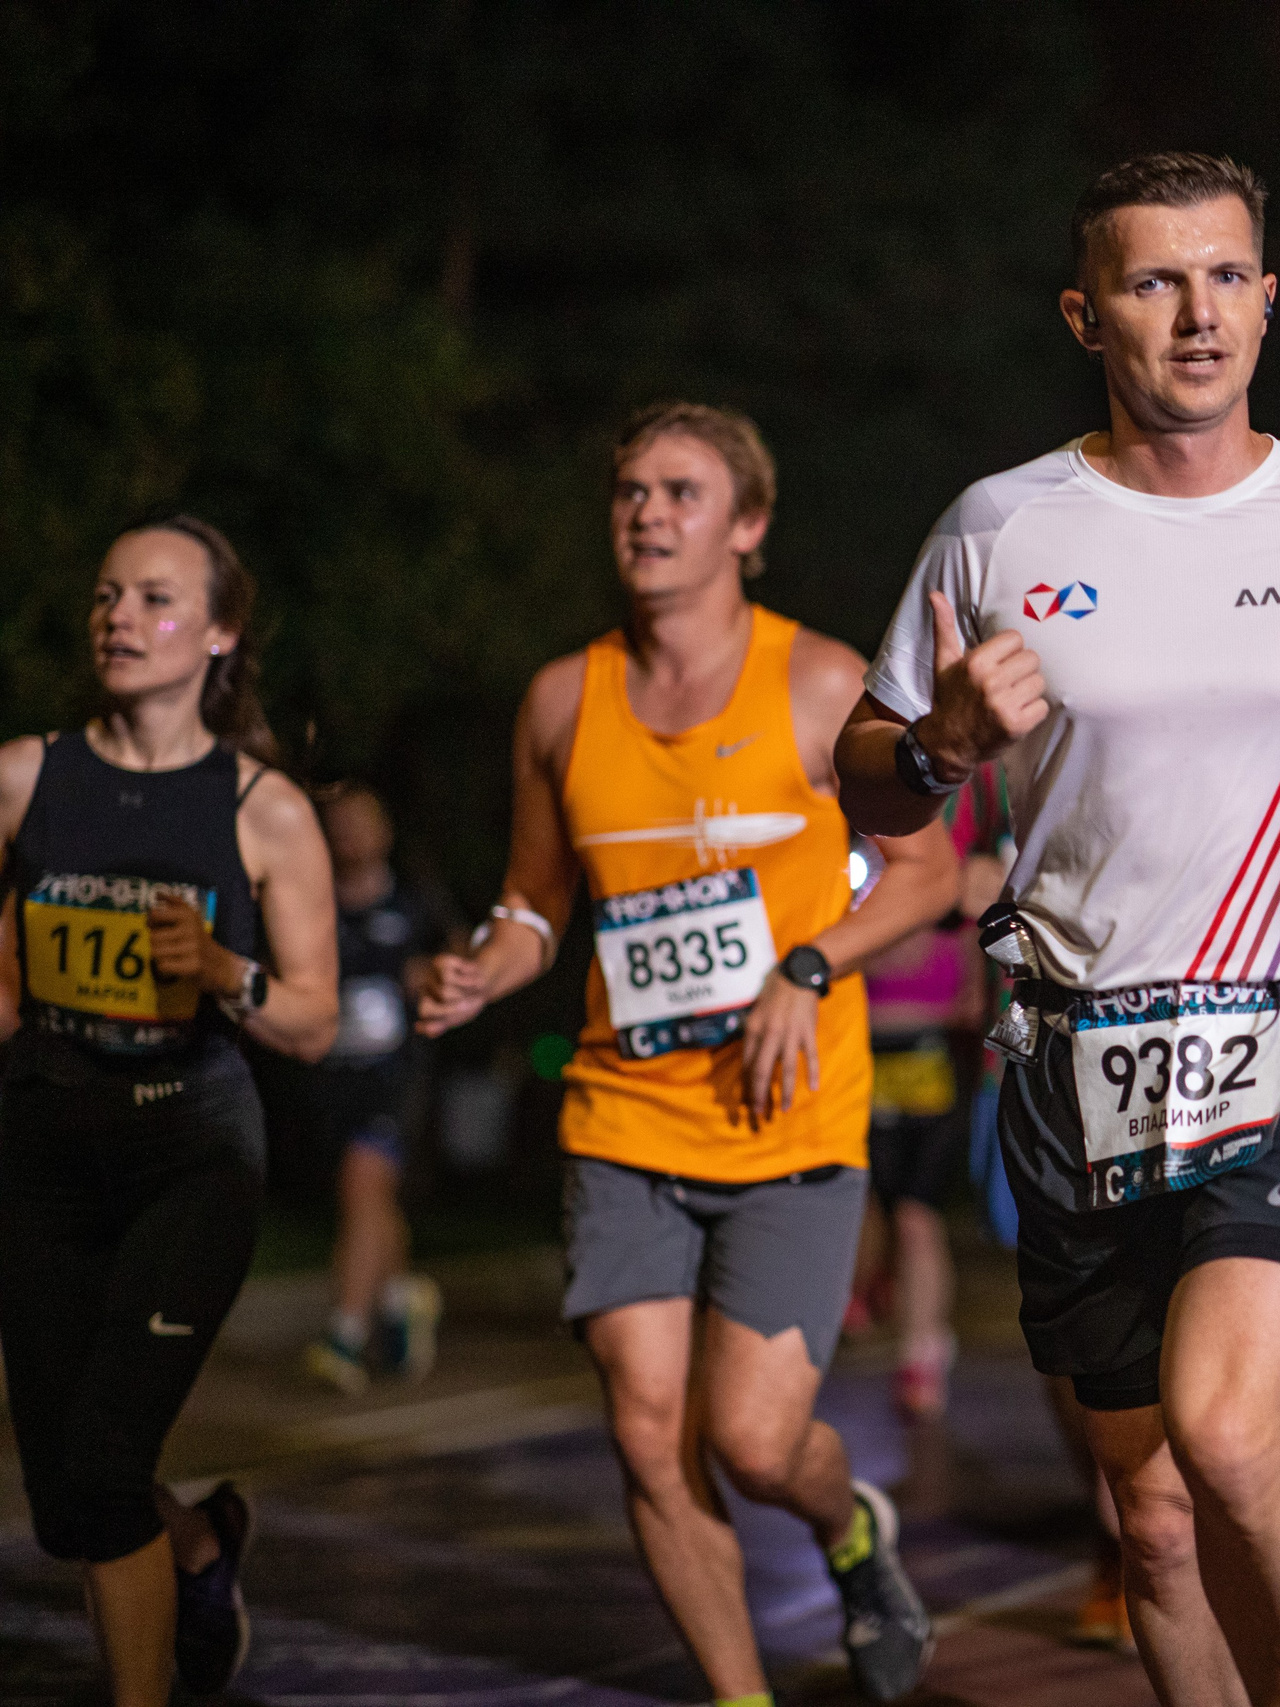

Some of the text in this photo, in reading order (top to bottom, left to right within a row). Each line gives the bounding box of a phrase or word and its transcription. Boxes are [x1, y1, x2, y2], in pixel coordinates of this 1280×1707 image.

[50, 923, 177, 985] 116
[627, 923, 747, 988] 8335
[1101, 1034, 1259, 1113] 9382
[1129, 1100, 1231, 1137] ВЛАДИМИР
